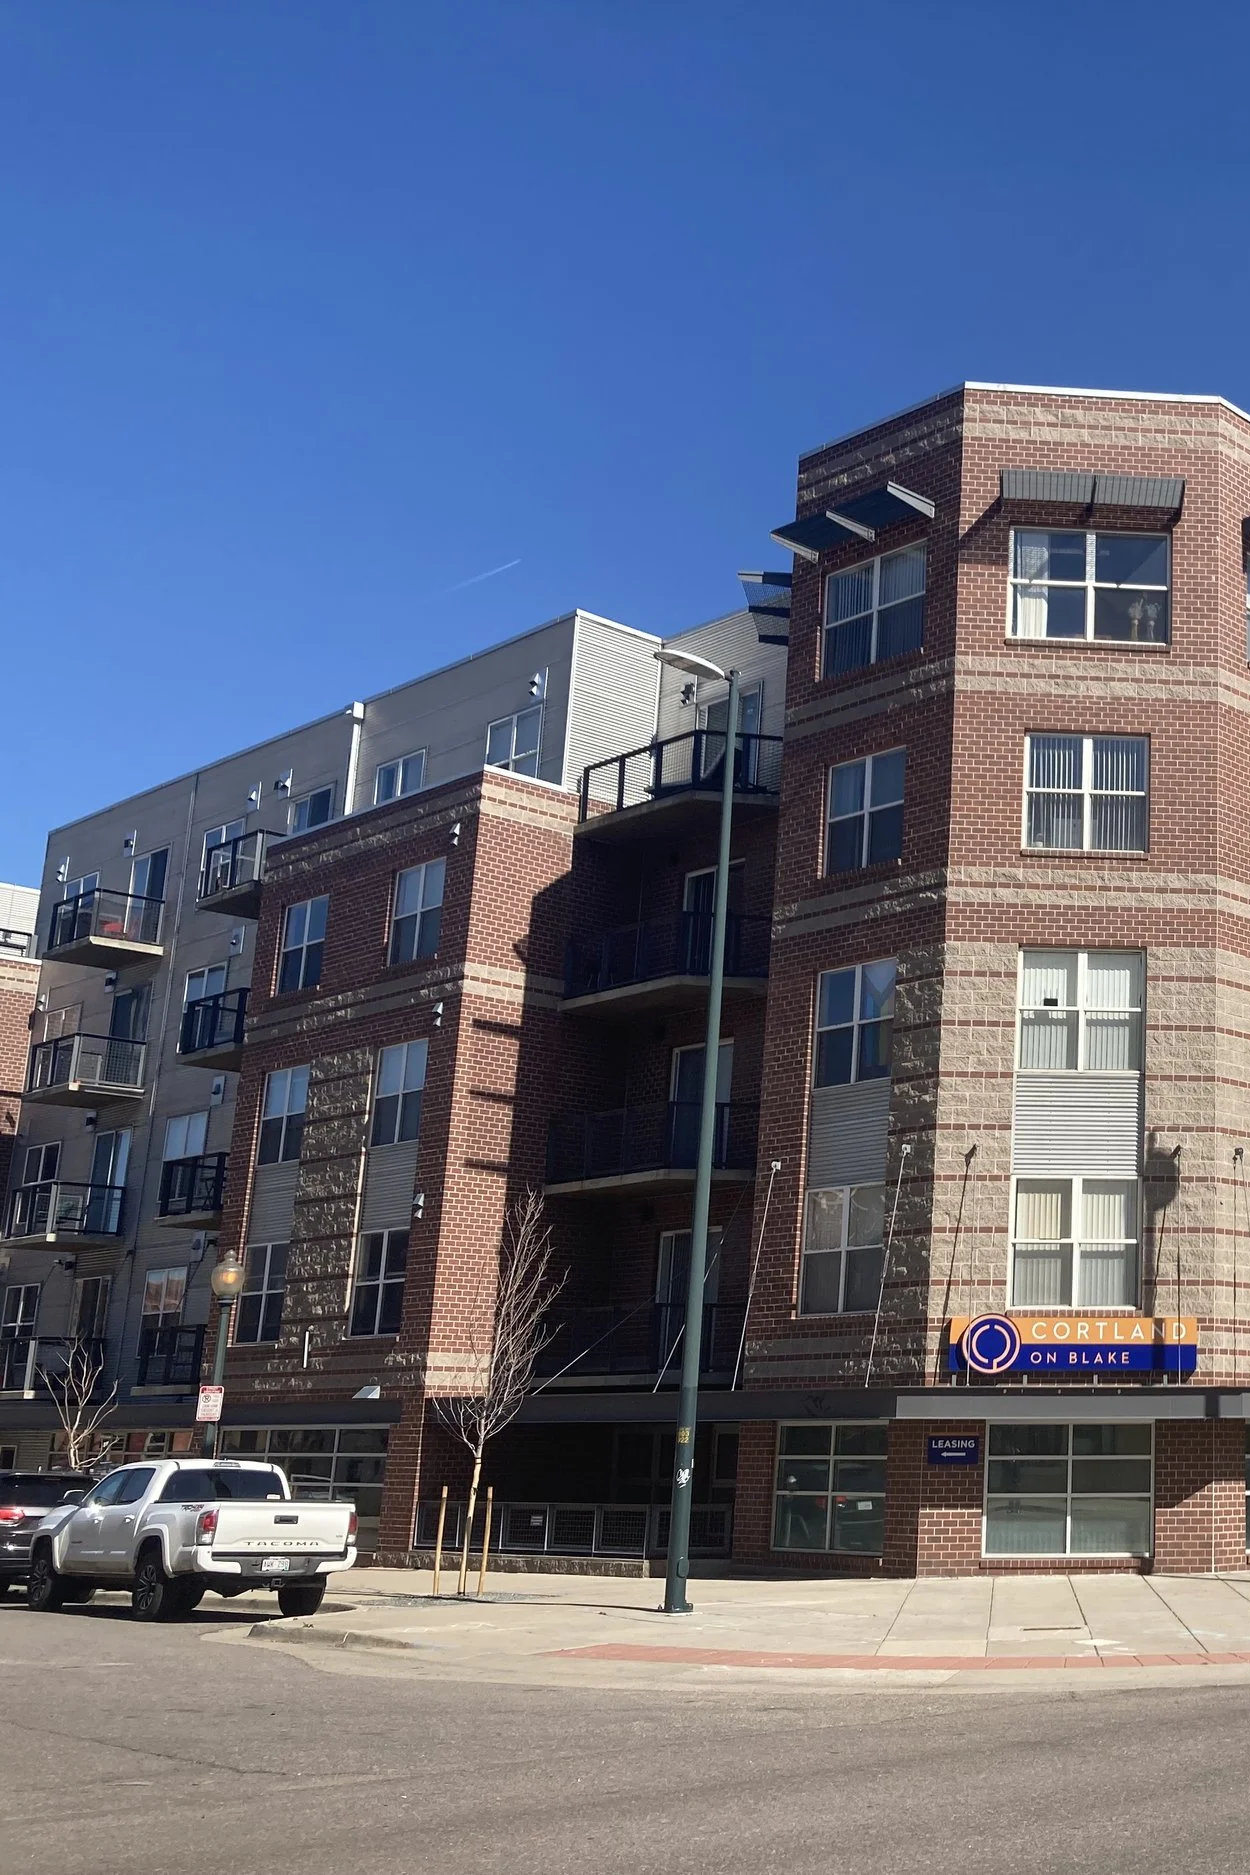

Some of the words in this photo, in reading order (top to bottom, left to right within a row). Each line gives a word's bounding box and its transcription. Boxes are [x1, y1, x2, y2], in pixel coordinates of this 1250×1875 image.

[1031, 1322, 1186, 1340] CORTLAND
[1030, 1351, 1057, 1364] ON
[1068, 1351, 1130, 1364] BLAKE
[932, 1439, 976, 1449] LEASING
